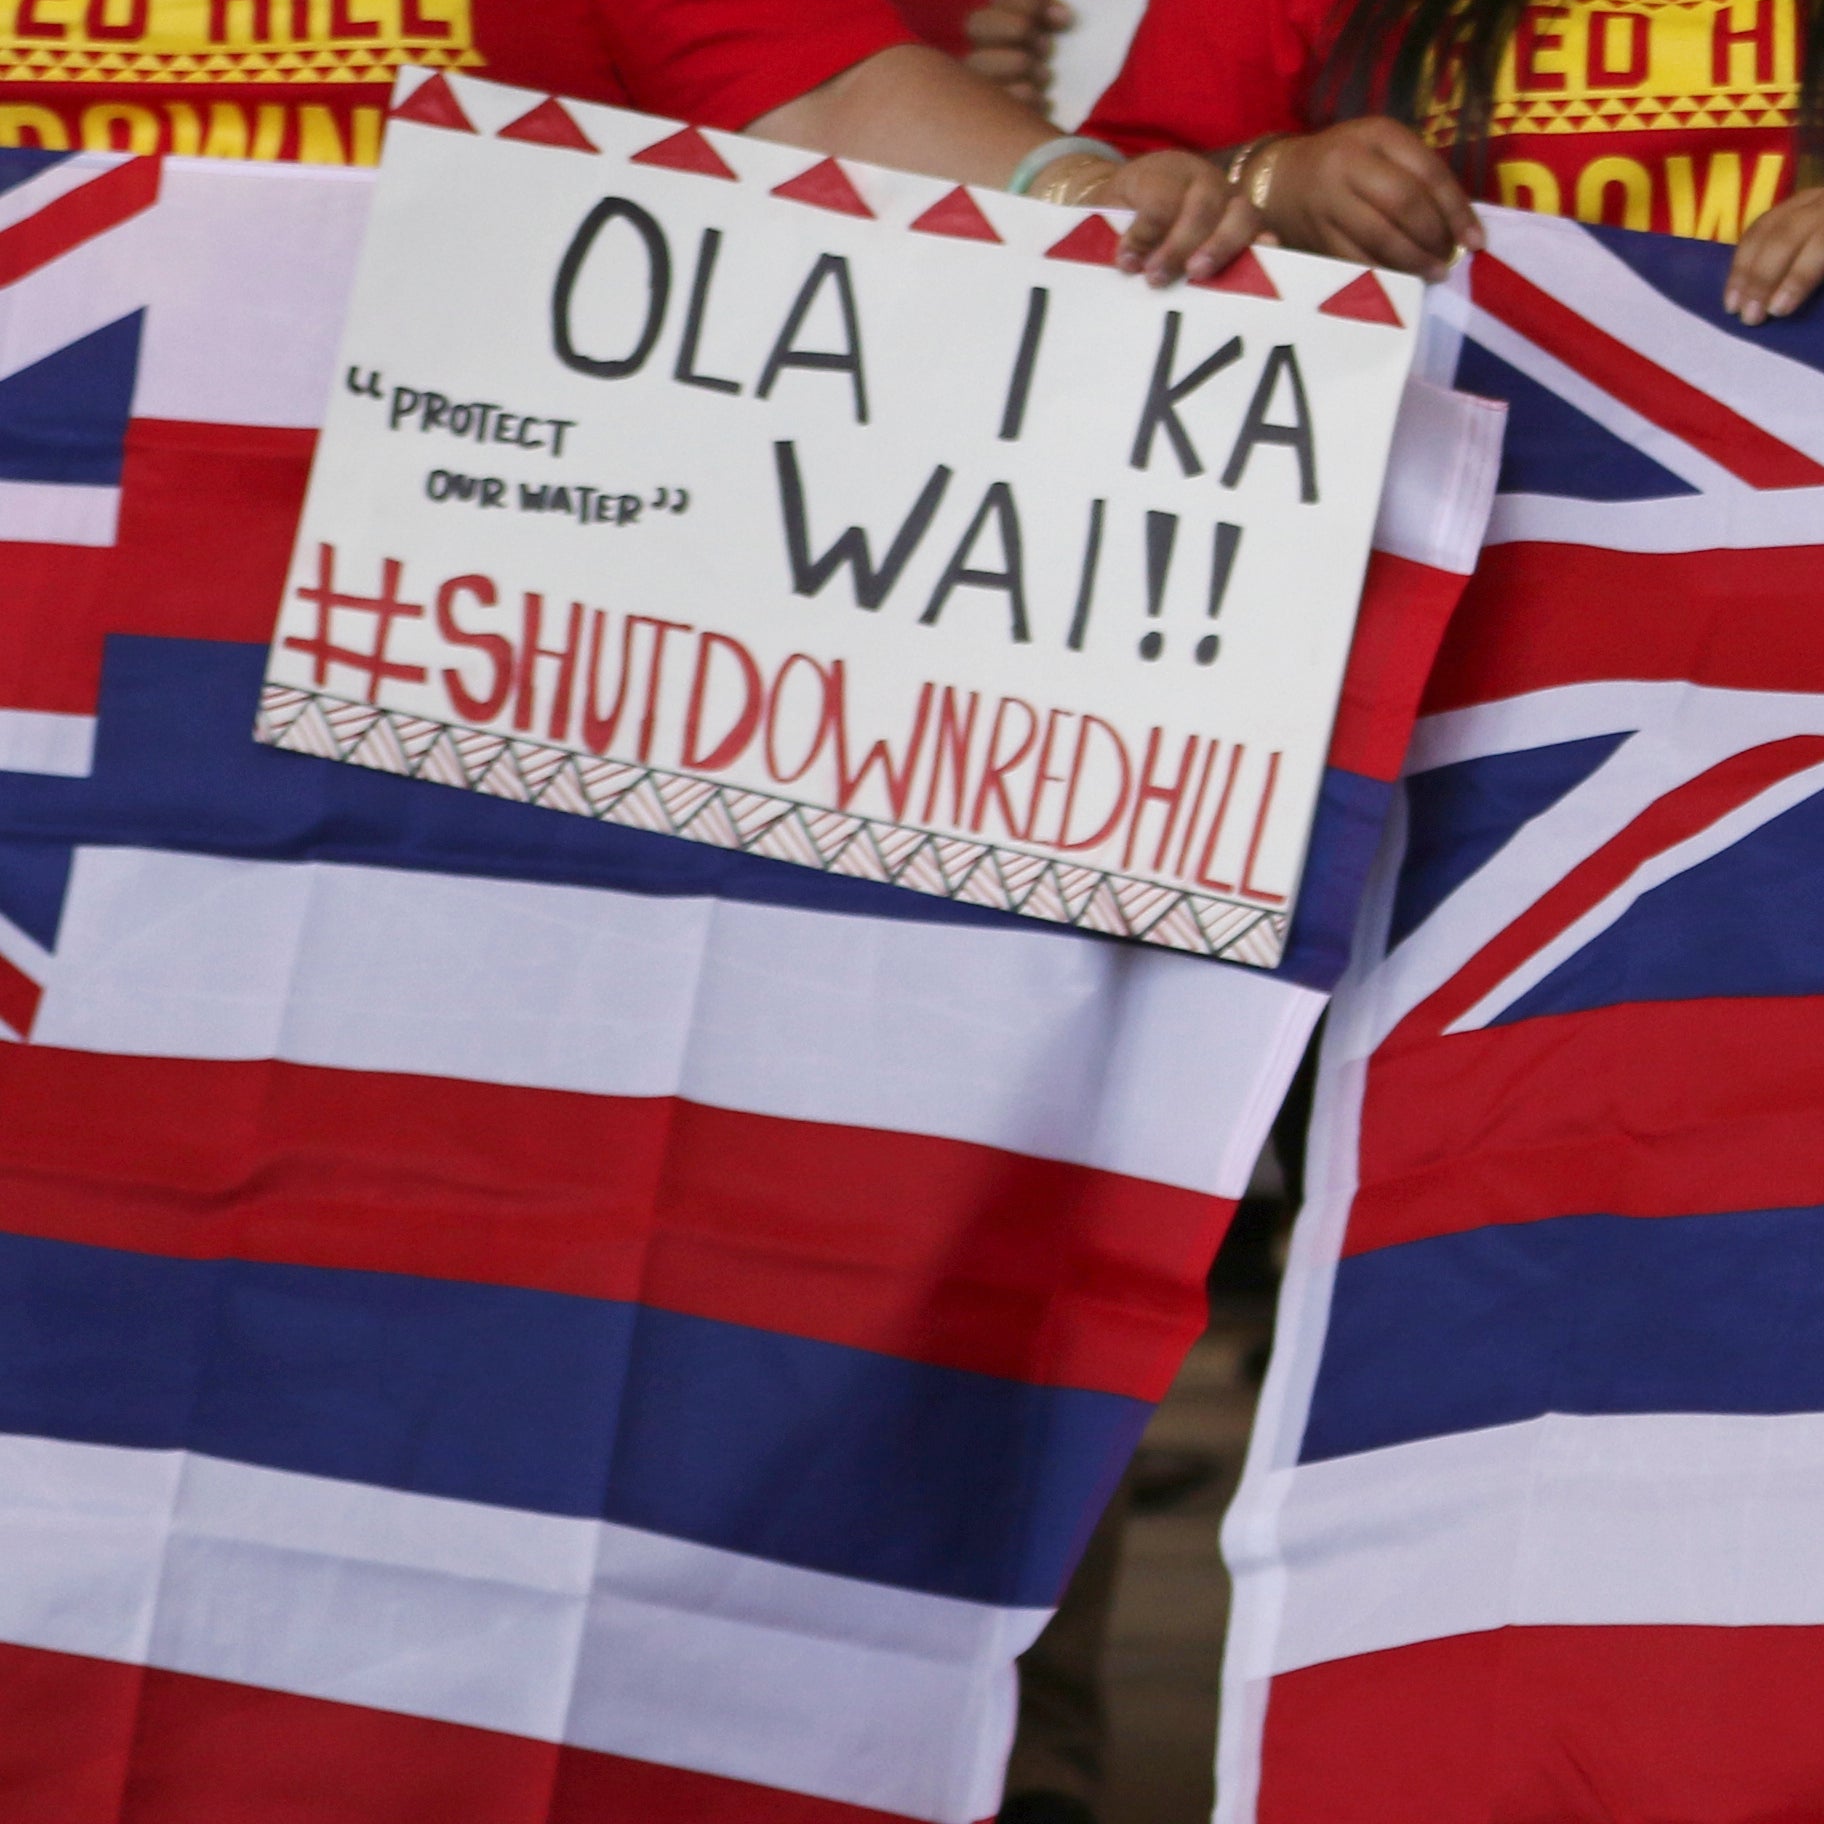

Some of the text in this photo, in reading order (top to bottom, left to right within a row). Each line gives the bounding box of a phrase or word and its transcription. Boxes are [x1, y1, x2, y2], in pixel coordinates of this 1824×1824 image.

[551, 196, 1320, 505] OLA I KA
[426, 469, 508, 510] OUR
[773, 439, 1244, 666] WAI!!
[284, 542, 1287, 903] #SHUTDOWNREDHILL
